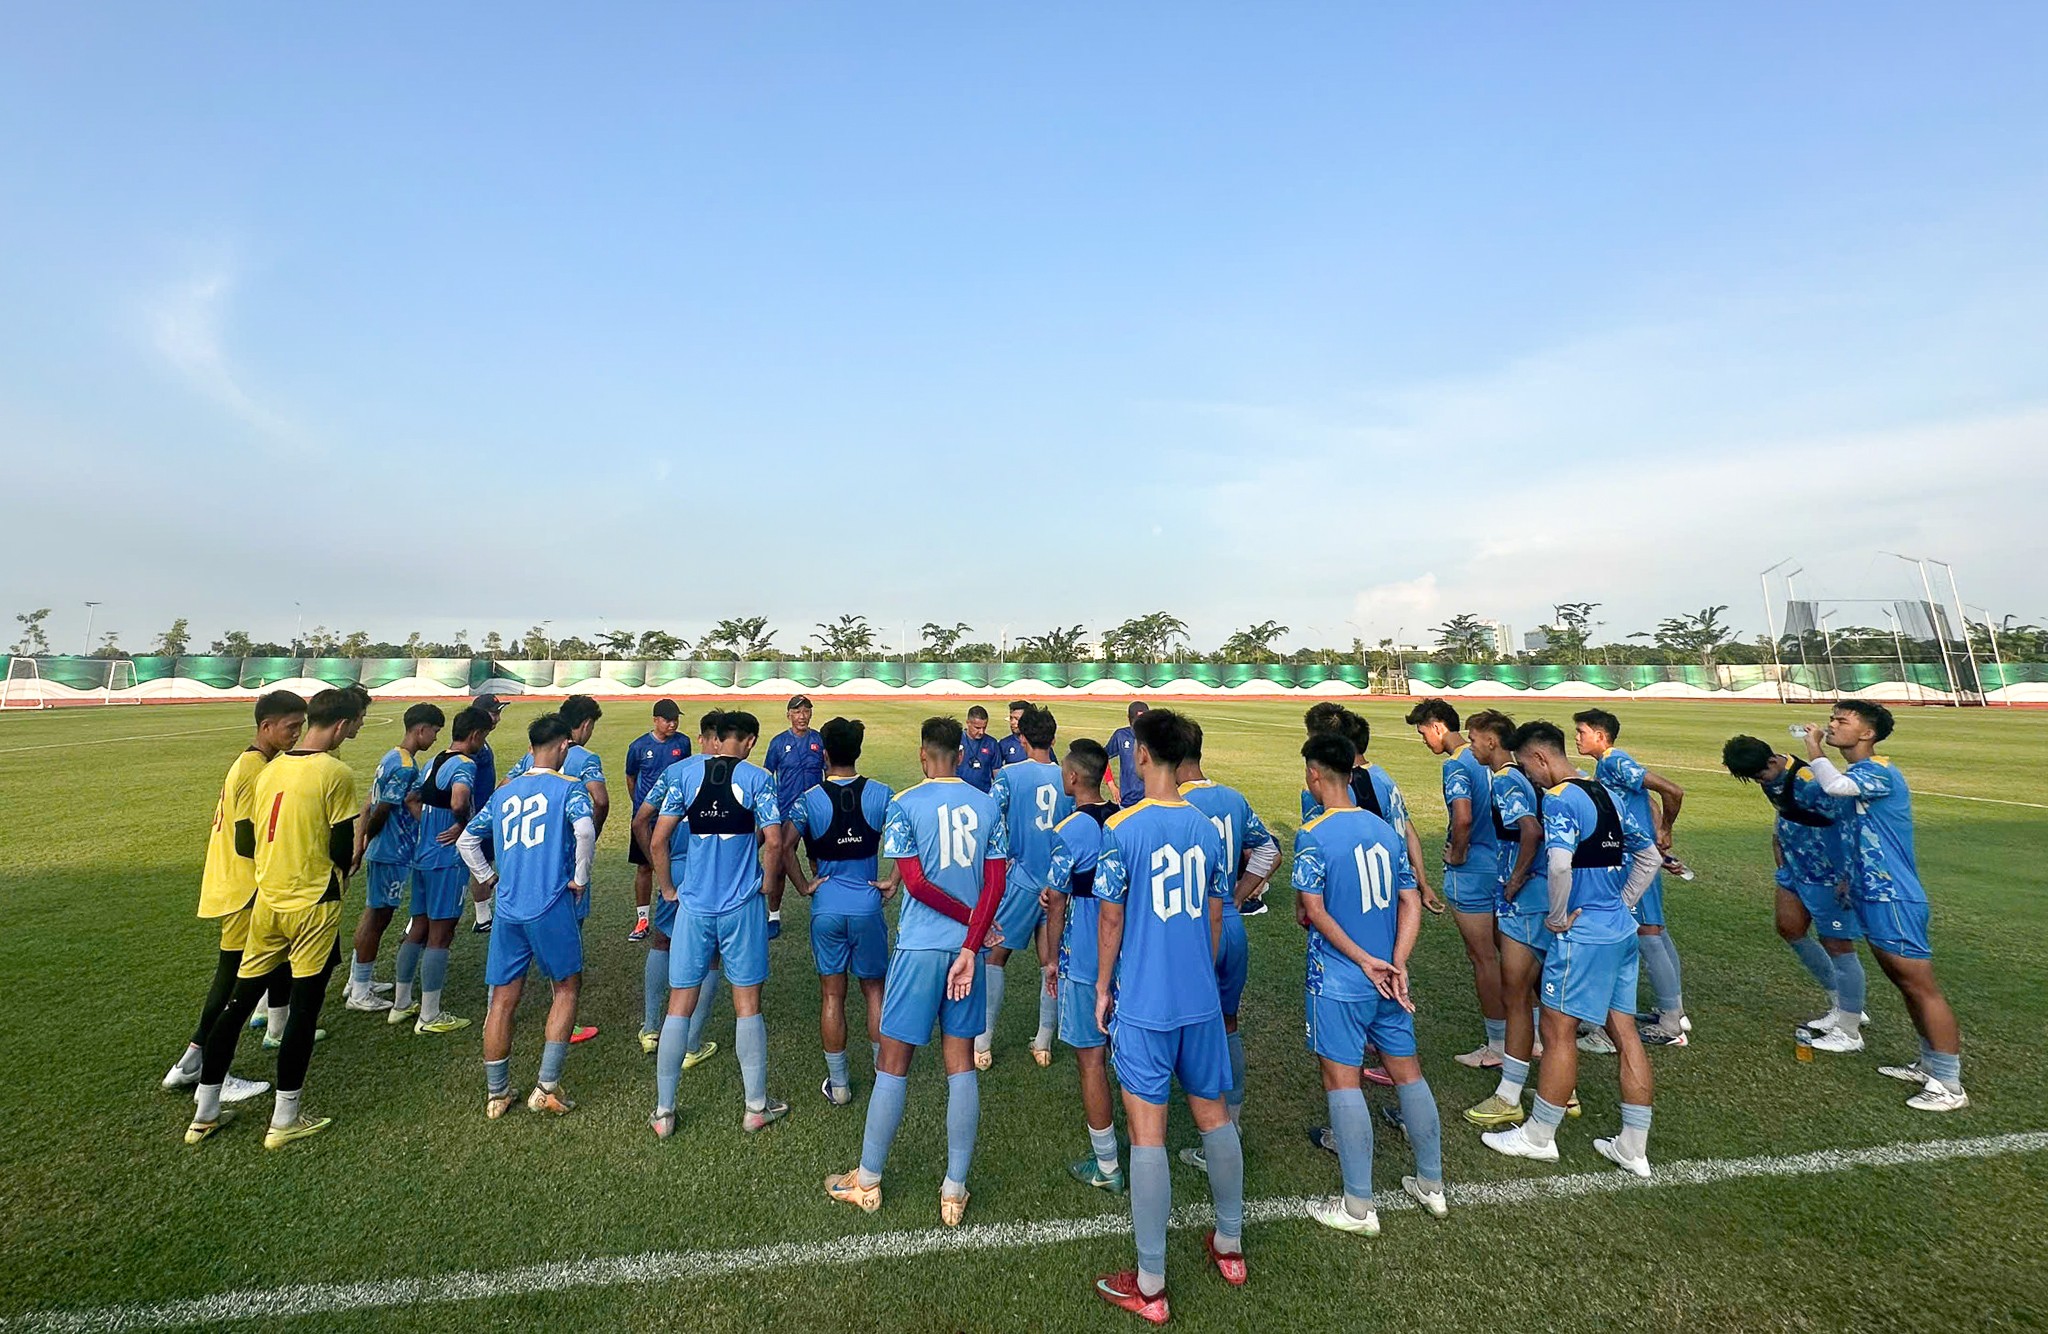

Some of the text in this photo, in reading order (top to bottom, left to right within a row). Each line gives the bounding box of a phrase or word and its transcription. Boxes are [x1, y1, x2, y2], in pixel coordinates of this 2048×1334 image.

[267, 790, 284, 843] 1
[501, 792, 549, 851] 22
[937, 803, 978, 870] 18
[1035, 783, 1058, 831] 9
[1150, 843, 1206, 922] 20
[1353, 841, 1393, 914] 10
